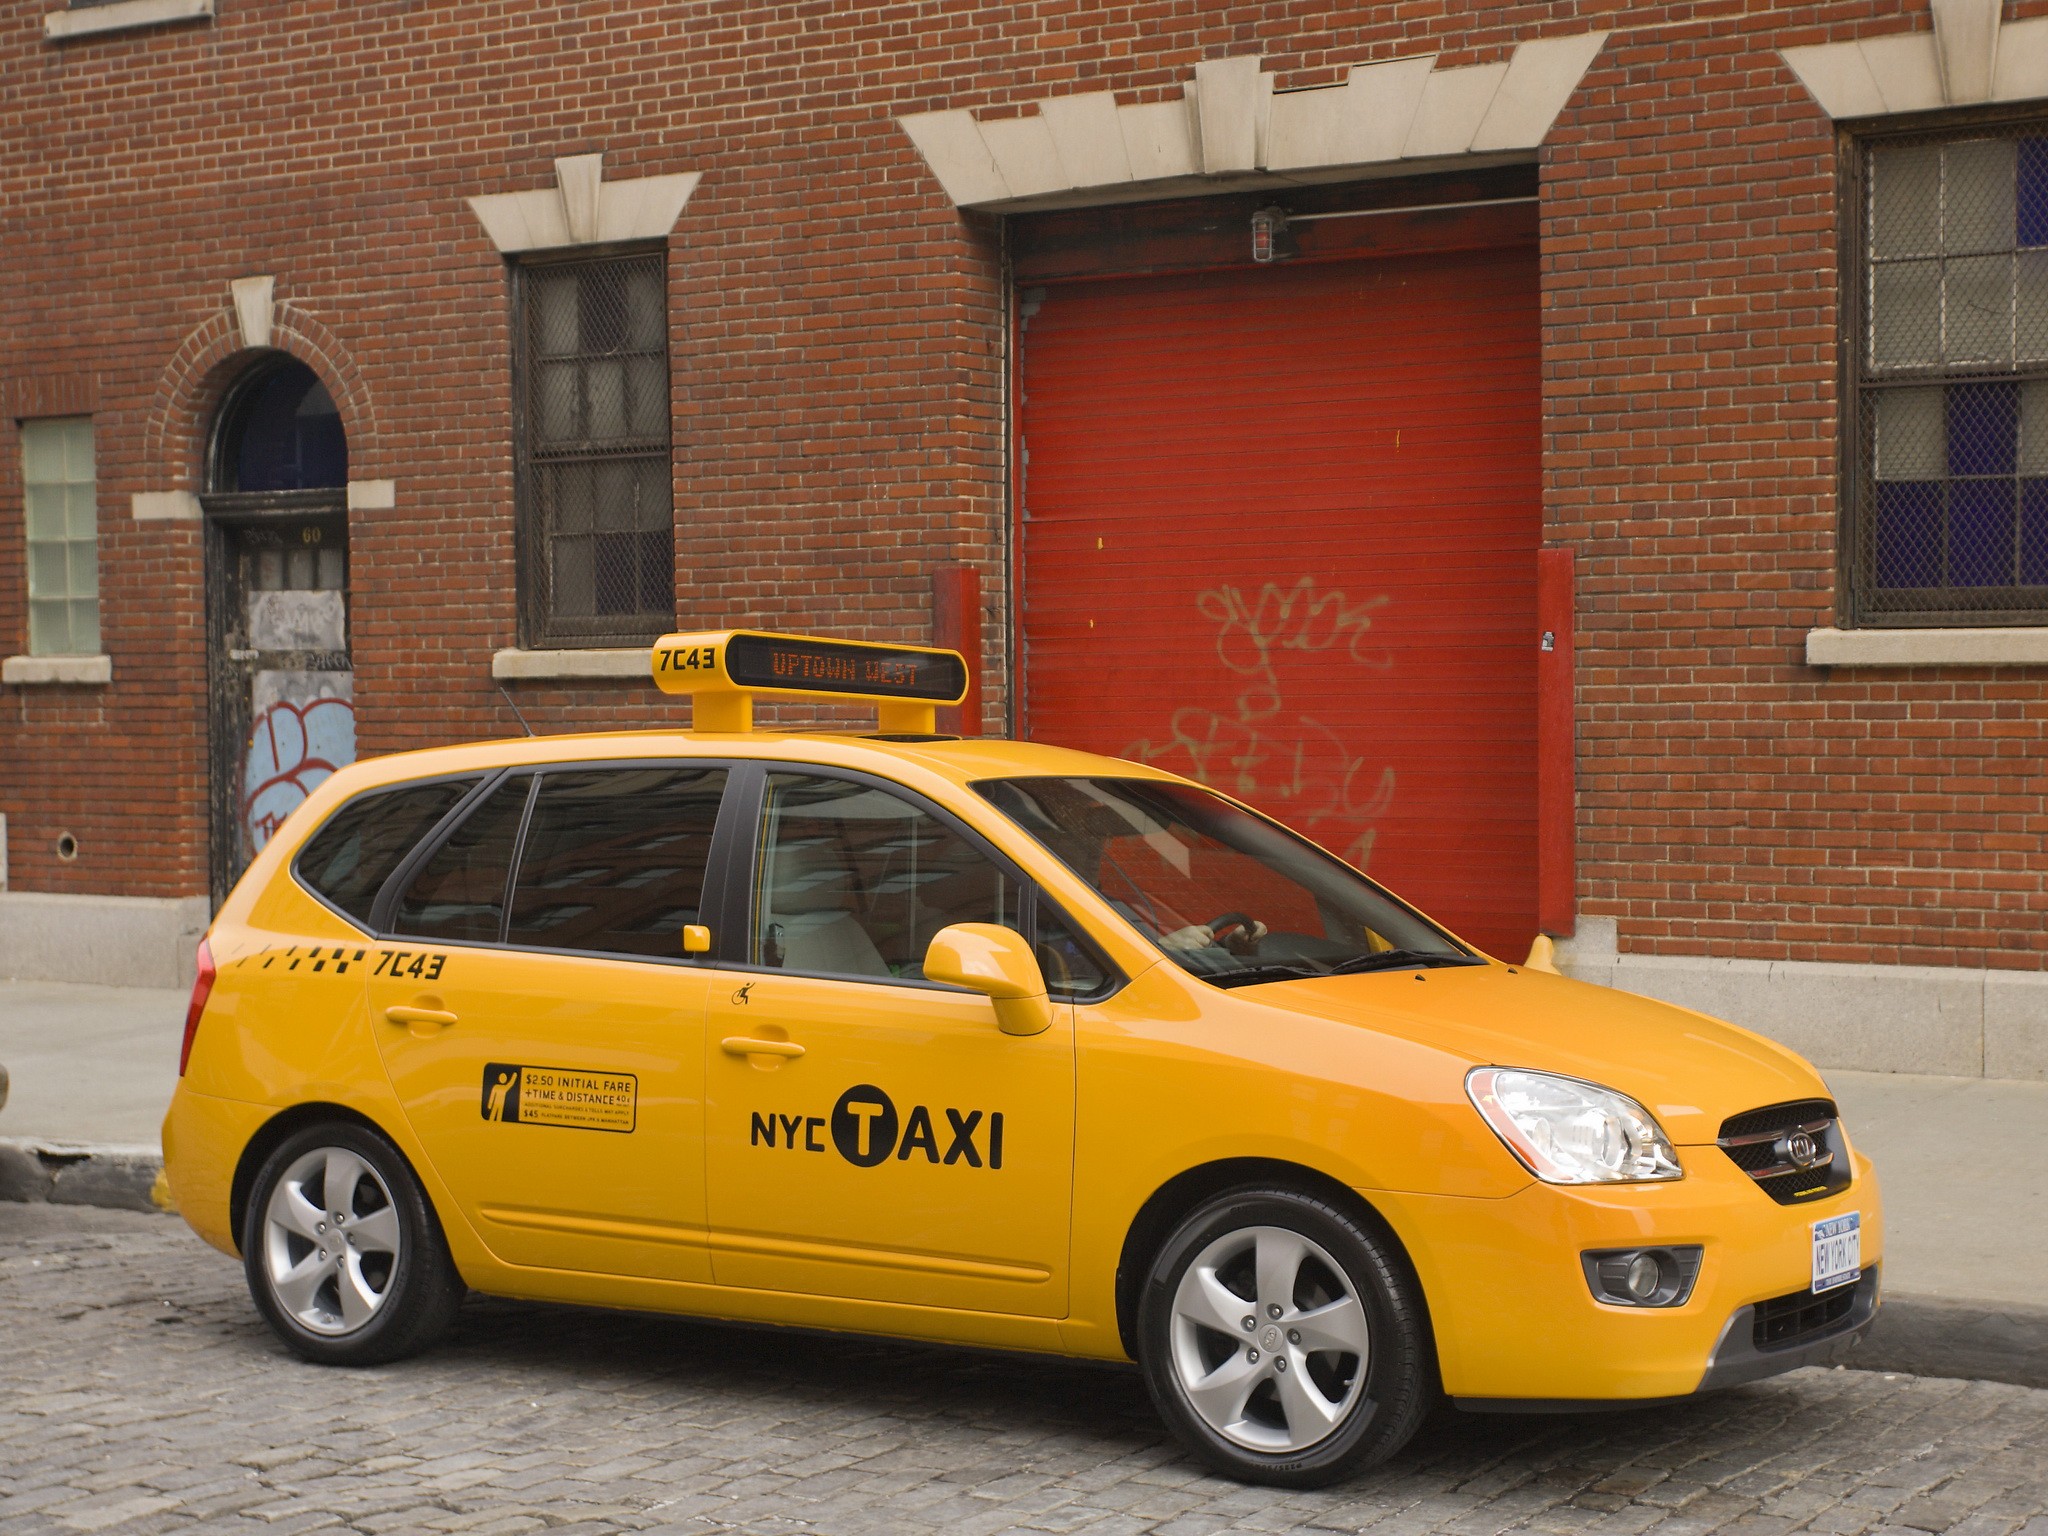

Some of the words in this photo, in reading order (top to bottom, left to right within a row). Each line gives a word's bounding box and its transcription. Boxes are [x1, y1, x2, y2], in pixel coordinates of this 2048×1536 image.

[302, 527, 322, 543] 60
[660, 647, 716, 671] 7C43
[772, 652, 856, 681] UPTOWN
[865, 660, 918, 686] WEST
[373, 950, 448, 980] 7C43
[526, 1074, 554, 1086] $2.50
[558, 1077, 599, 1090] INITIAL
[603, 1081, 631, 1093] FARE
[557, 1092, 564, 1101] &
[566, 1092, 615, 1106] DISTANCE
[751, 1111, 826, 1153] NYC
[836, 1092, 1004, 1170] TAXI
